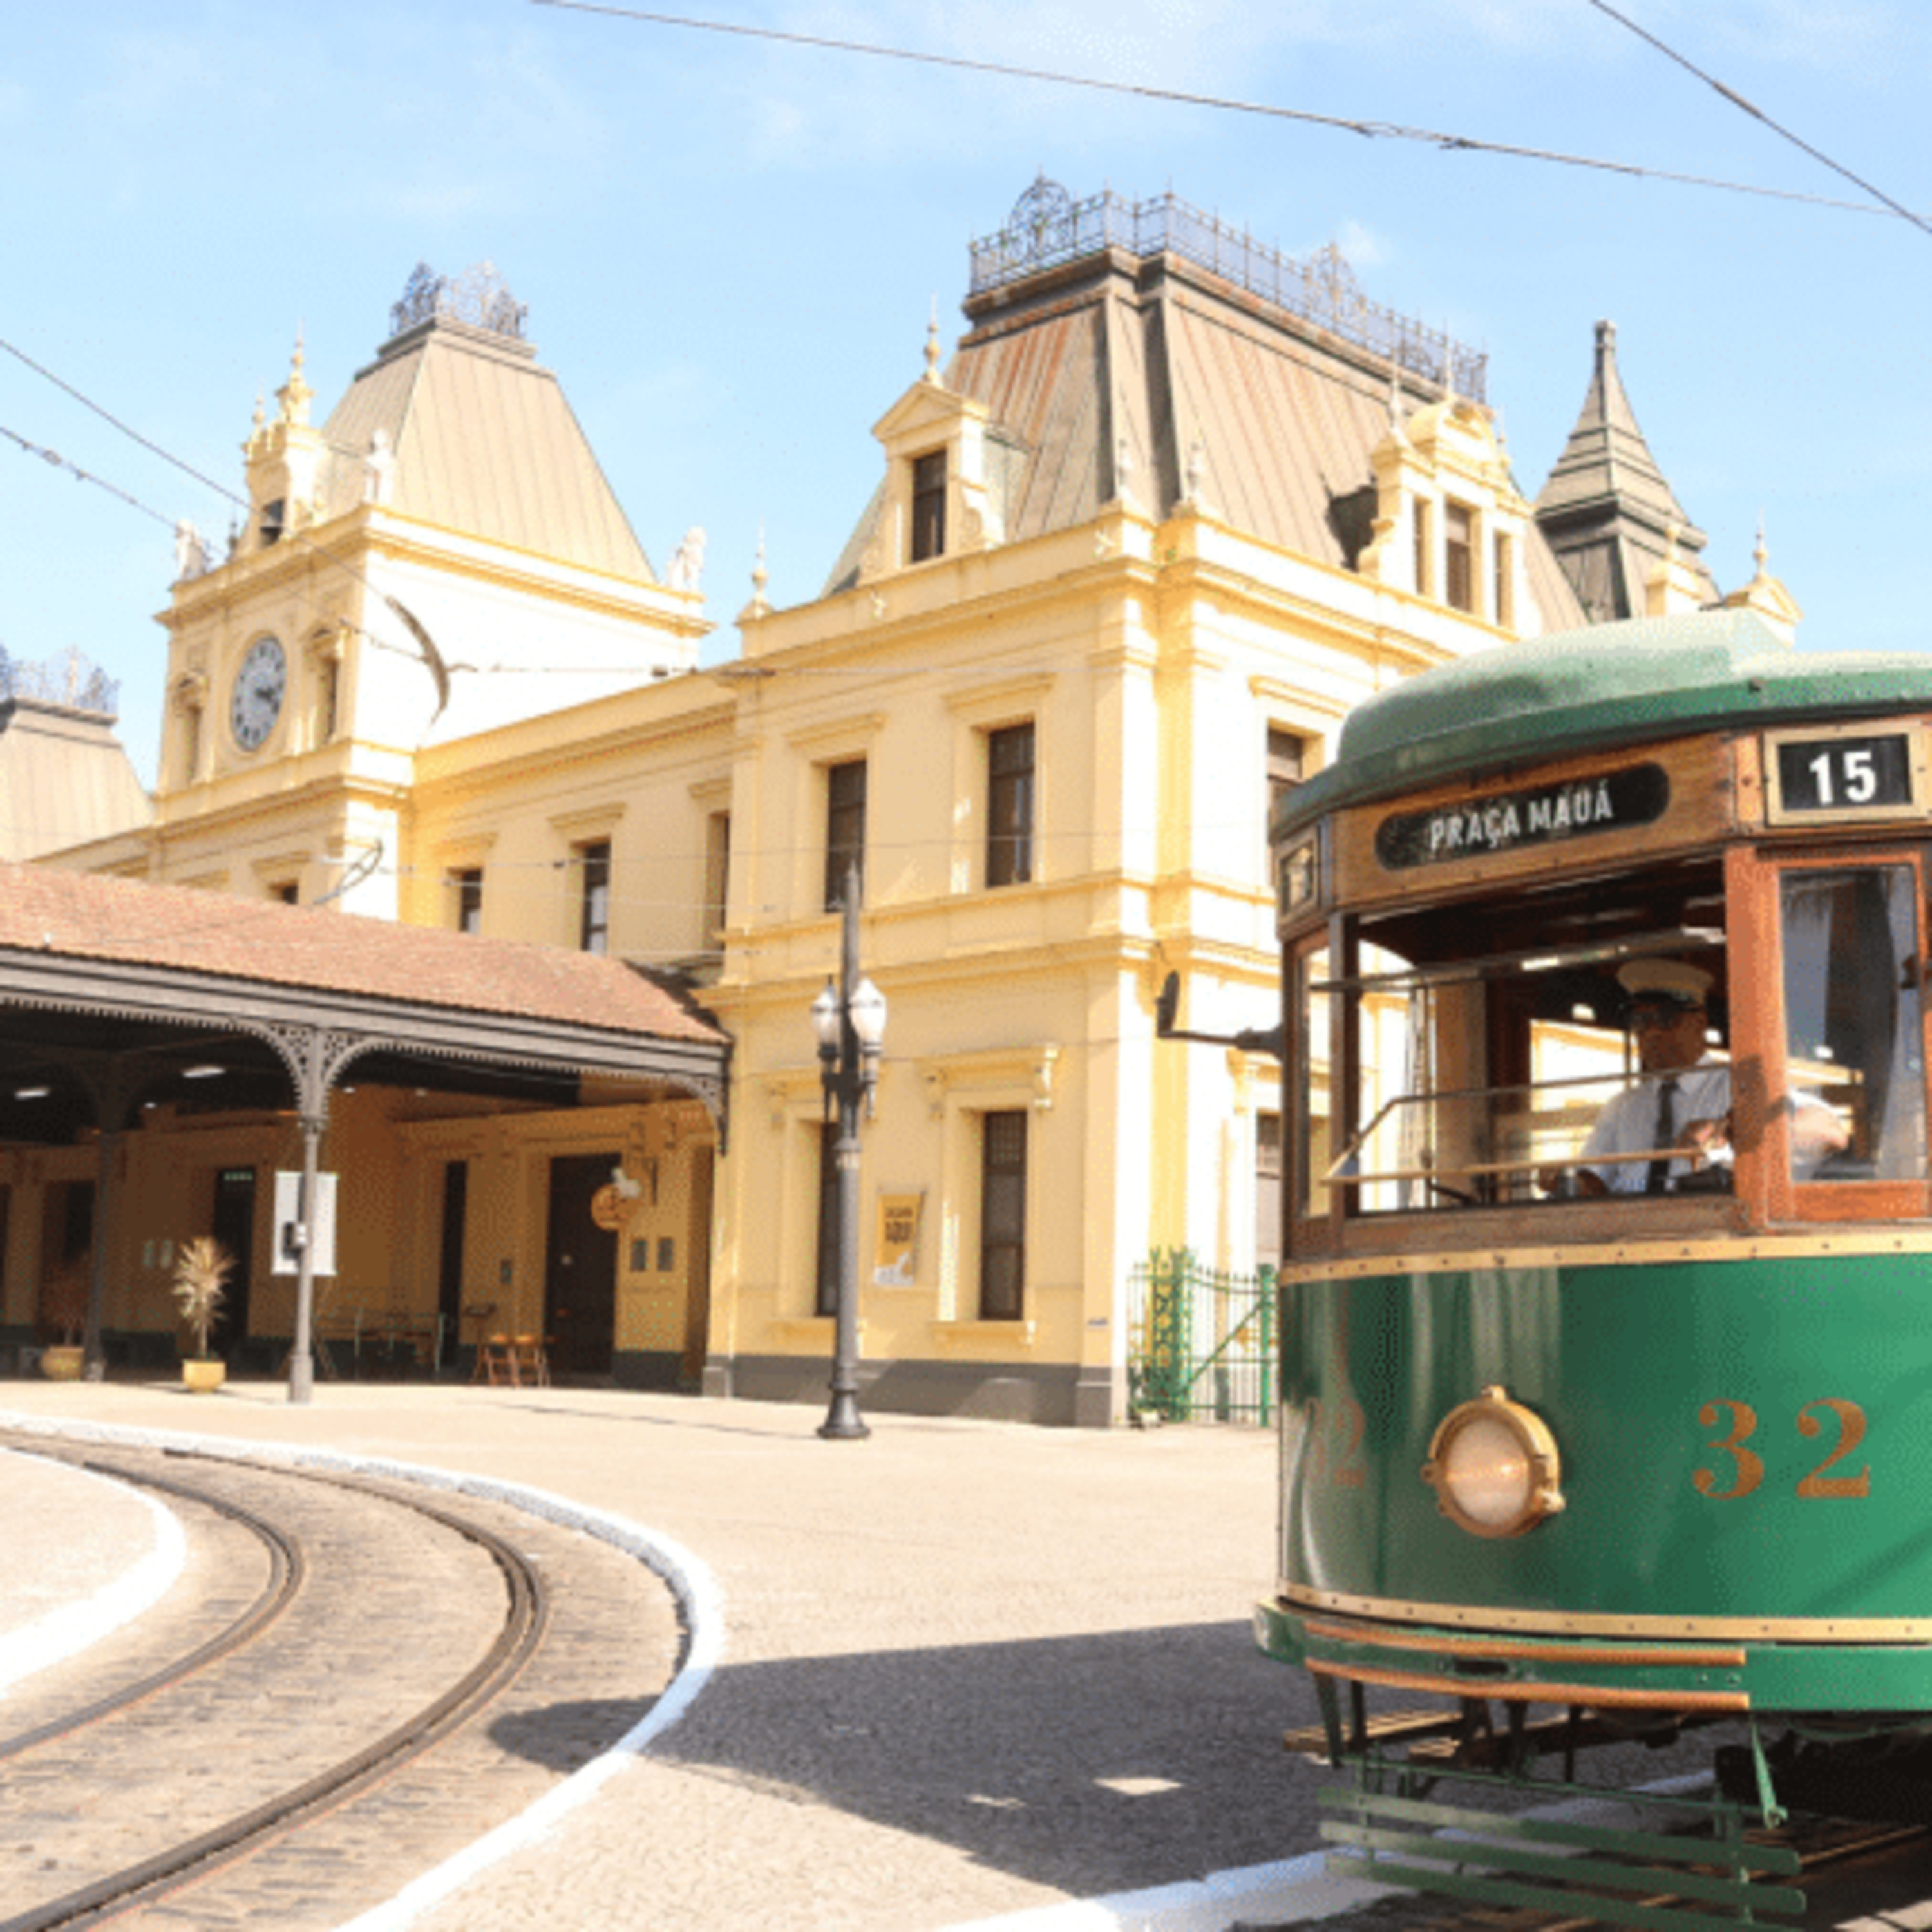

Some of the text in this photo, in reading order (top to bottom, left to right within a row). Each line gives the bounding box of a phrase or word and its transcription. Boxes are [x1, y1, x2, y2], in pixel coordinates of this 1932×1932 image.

[1810, 750, 1876, 805] 15
[1430, 779, 1613, 851] PRAÇA MAUÁ
[1692, 1397, 1871, 1500] 32
